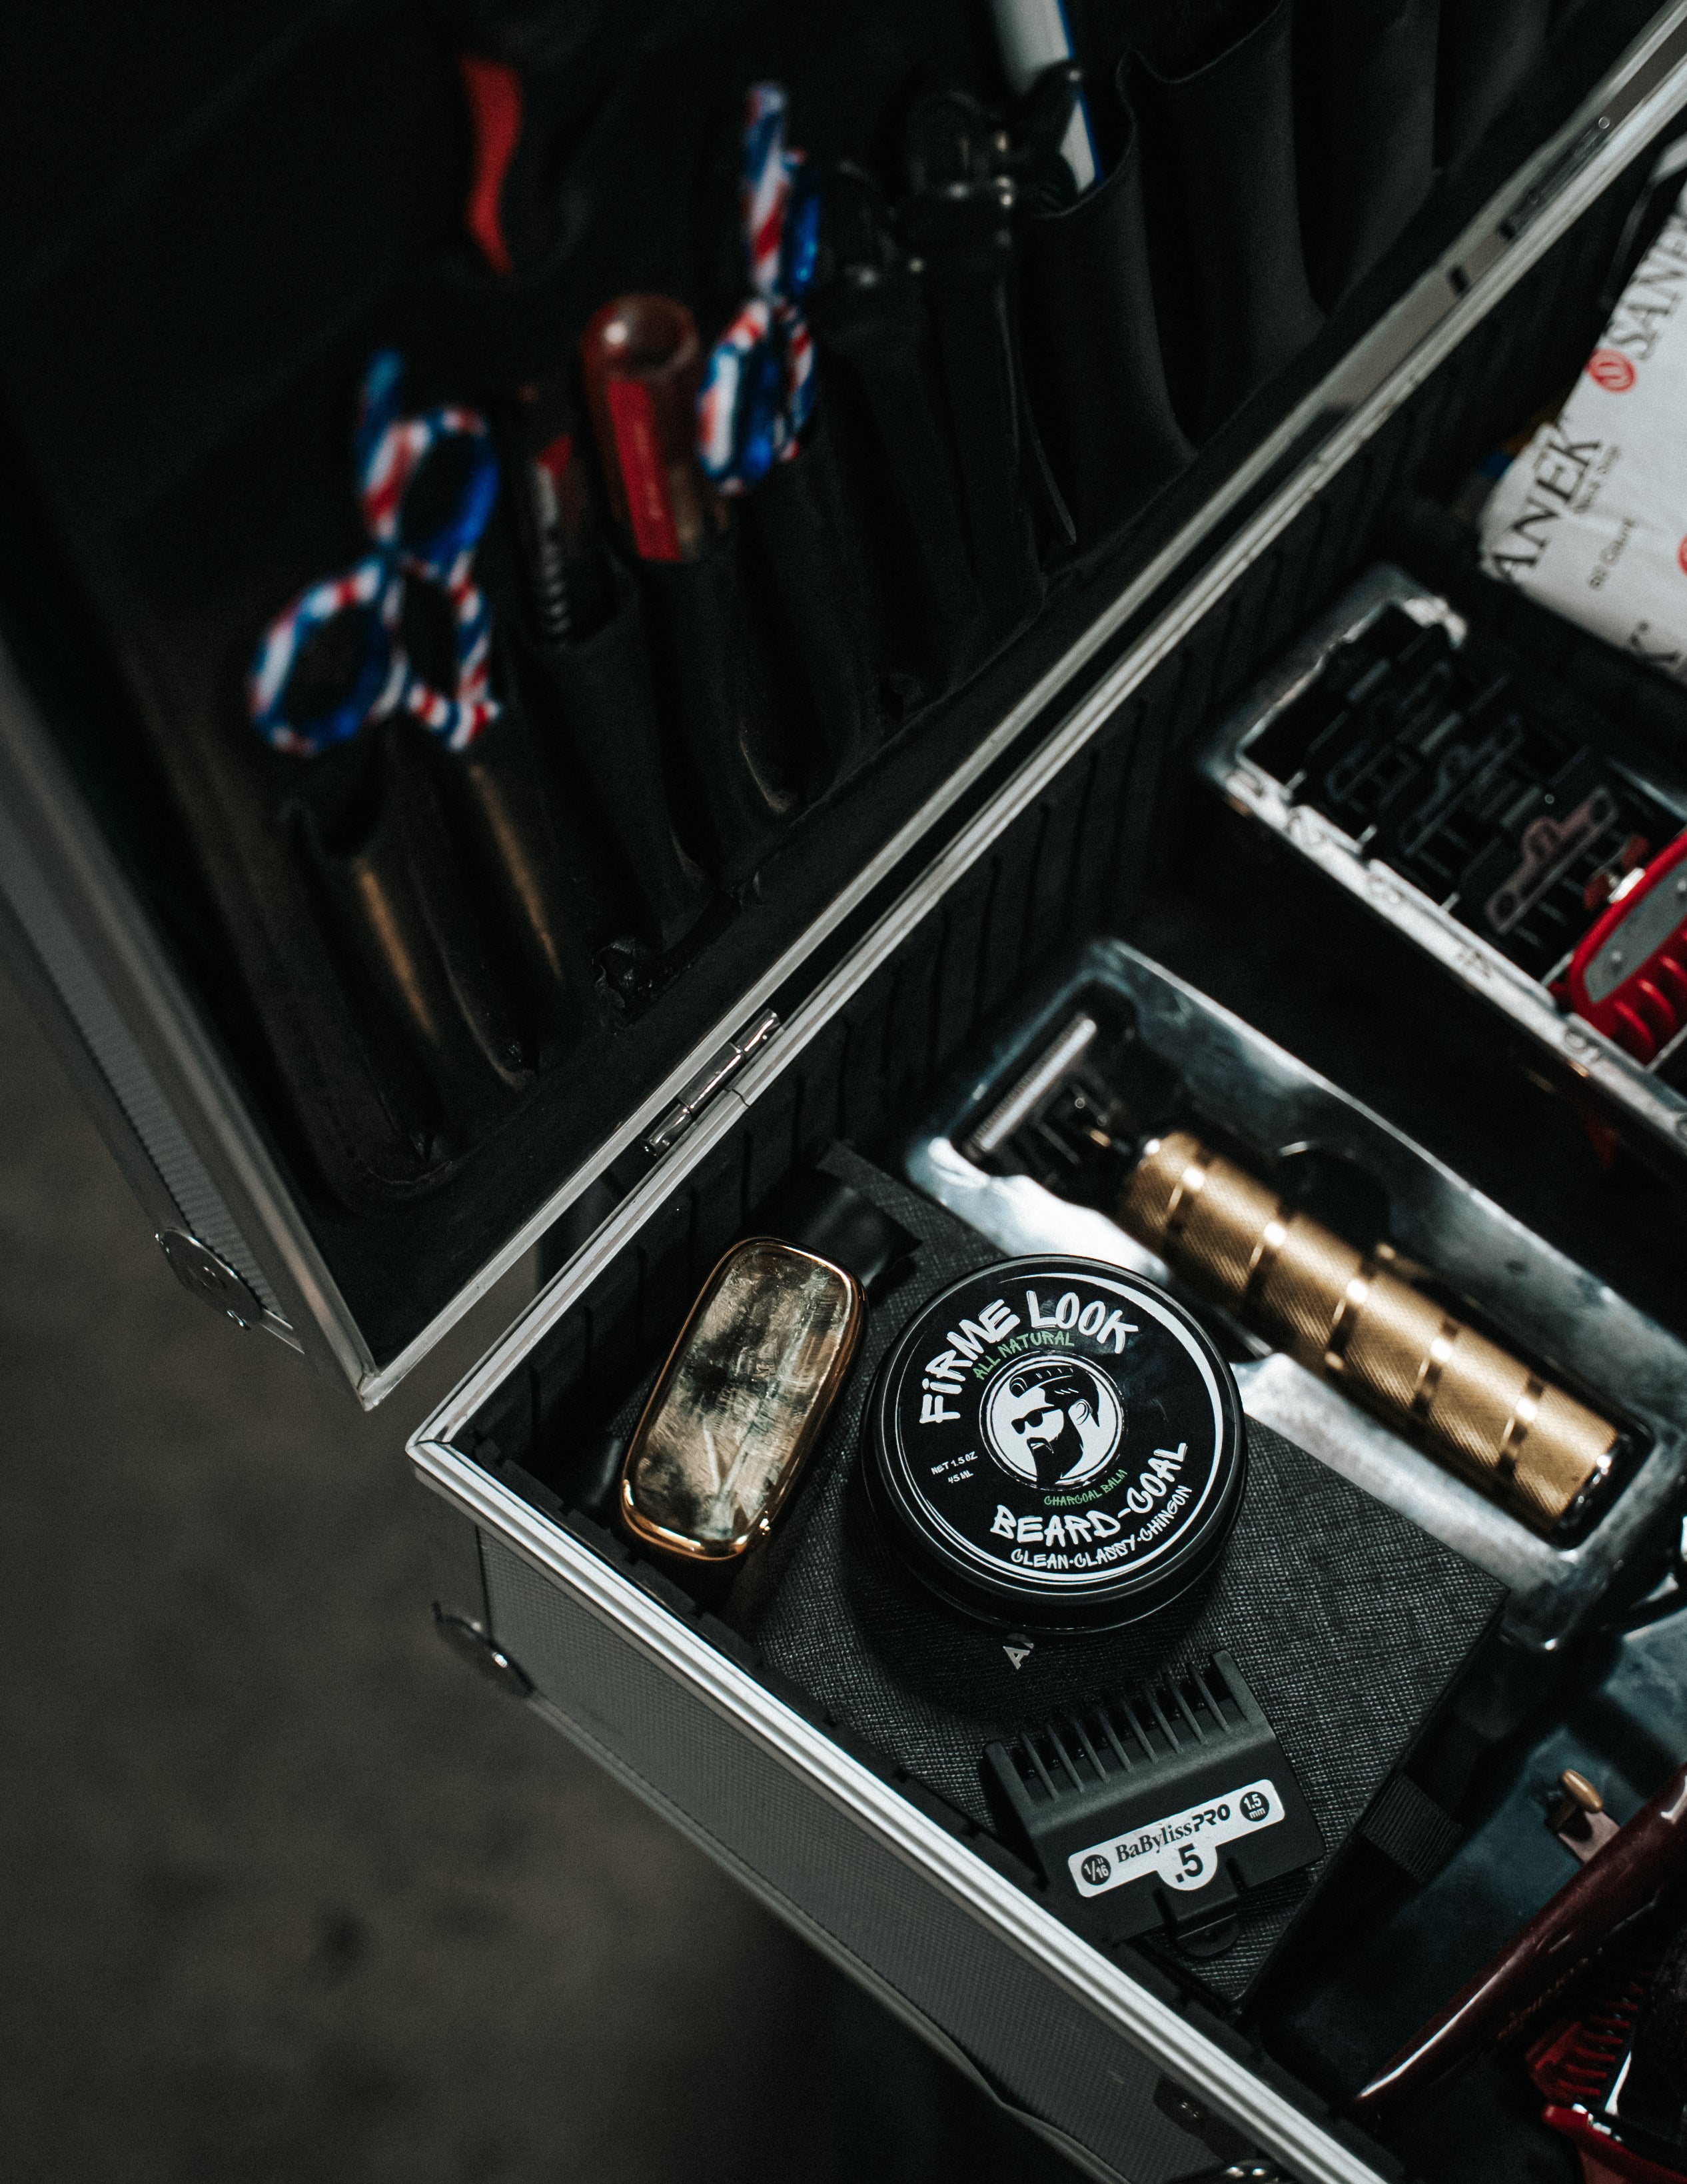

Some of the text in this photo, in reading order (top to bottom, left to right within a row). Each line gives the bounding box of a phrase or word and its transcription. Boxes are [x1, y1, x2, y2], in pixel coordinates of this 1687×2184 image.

[1027, 1290, 1139, 1354] LOOK
[973, 1330, 1075, 1380] ALL NATURAL
[931, 1451, 977, 1475] NET 1.5 OZ
[947, 1470, 973, 1484] 45 ML
[1043, 1468, 1128, 1506] CHARCOAL BALM
[1243, 1793, 1262, 1810] 1.5
[1248, 1807, 1266, 1819] mm
[1175, 1843, 1203, 1883] .5
